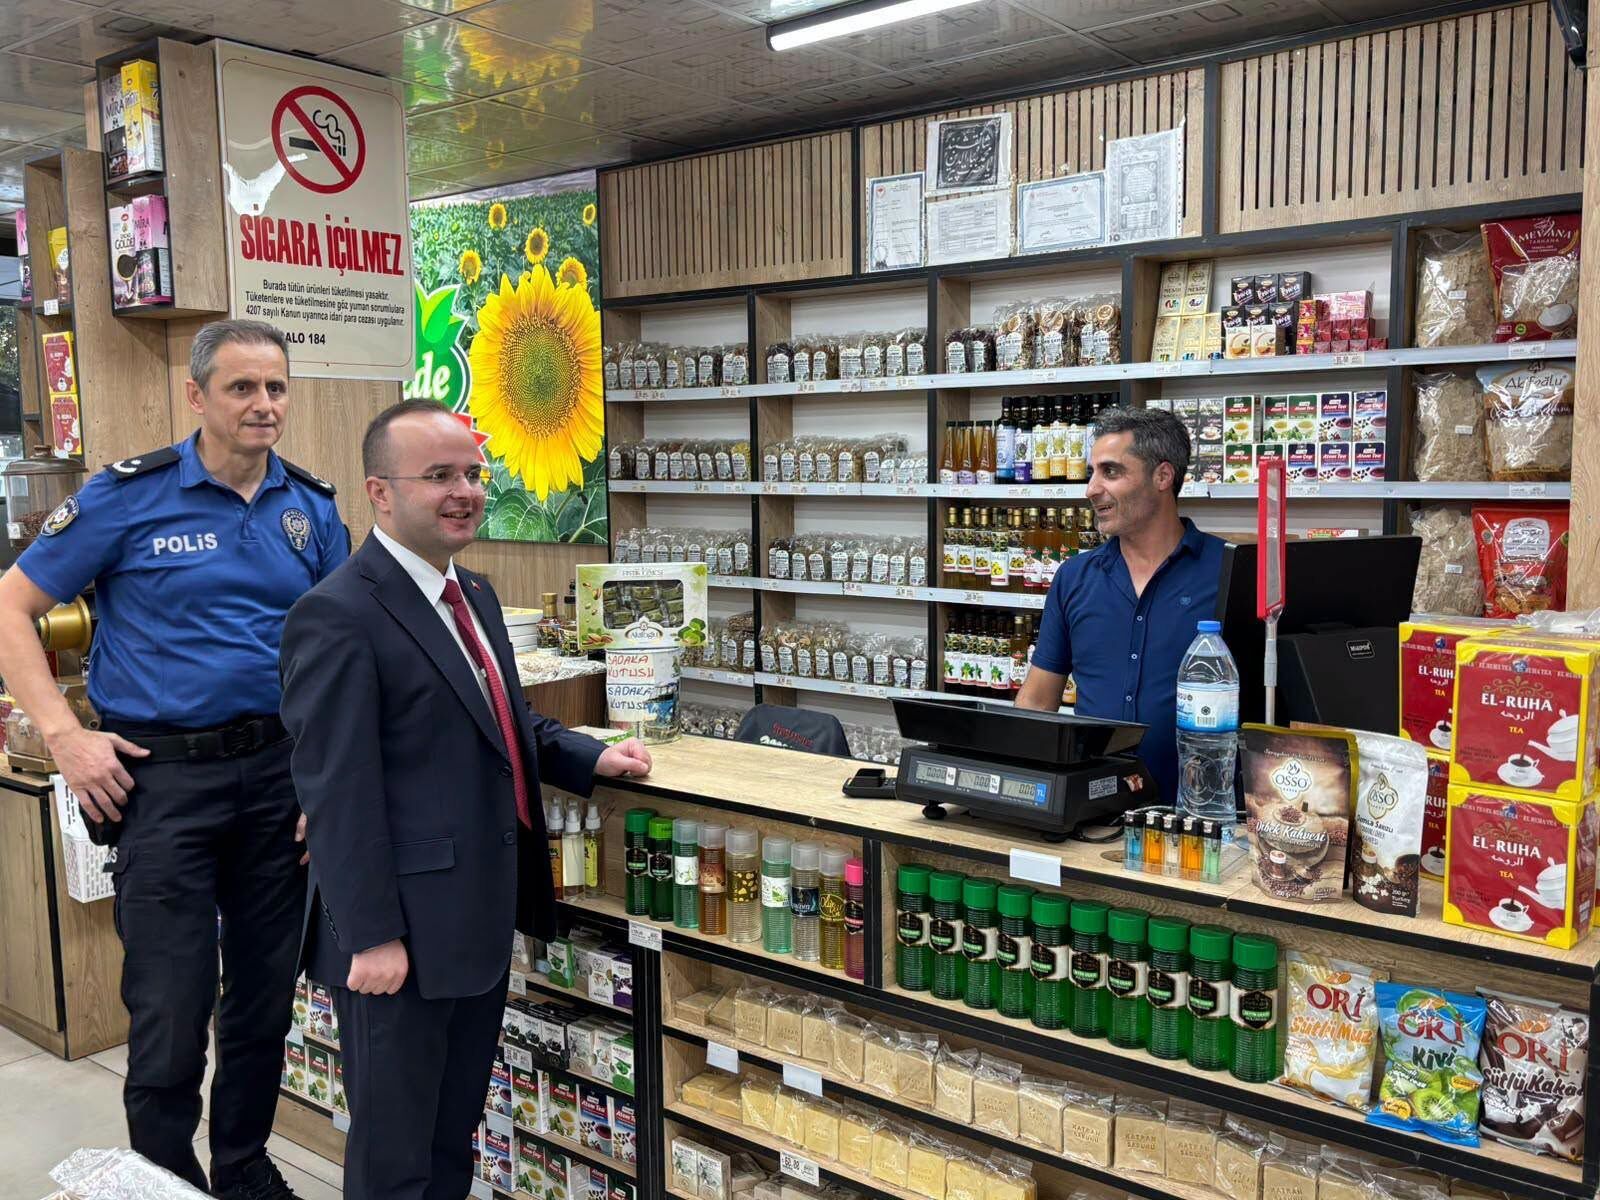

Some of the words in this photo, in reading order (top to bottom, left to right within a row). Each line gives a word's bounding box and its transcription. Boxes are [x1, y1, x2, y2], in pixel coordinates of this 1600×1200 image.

[240, 203, 322, 268] SİGARA
[325, 214, 405, 276] İÇİLMEZ
[263, 279, 286, 291] Burada
[288, 282, 305, 293] tütün
[306, 283, 331, 295] ürünleri
[331, 286, 364, 298] tüketilmesi
[365, 289, 390, 301] yasaktır.
[246, 291, 284, 304] Tüketenlere
[285, 296, 293, 304] ve
[295, 296, 336, 308] tüketilmesine
[337, 300, 348, 311] göz
[349, 301, 370, 313] yuman
[370, 302, 405, 315] sorumlulara
[246, 305, 261, 315] 4207
[262, 307, 280, 319] sayılı
[281, 308, 301, 318] Kanun
[302, 312, 329, 322] uyarınca
[344, 315, 357, 324] para
[358, 315, 377, 324] cezası
[285, 333, 305, 344] ALO
[308, 333, 326, 344] 184
[608, 655, 649, 666] SADAKA
[1418, 665, 1455, 679] EL-RUH
[1481, 693, 1553, 712] EL-RUHA
[1509, 726, 1524, 734] TEA
[1276, 774, 1308, 788] OSSO
[1037, 789, 1045, 797] TL
[1283, 826, 1326, 842] Kahvesi
[1473, 836, 1541, 858] EL-RUHA
[1499, 870, 1514, 879] TEA
[1290, 1015, 1337, 1038] Sütlü
[1339, 1023, 1373, 1044] Muz
[1483, 1068, 1527, 1092] Sütlü
[1125, 1133, 1157, 1143] KATRAN
